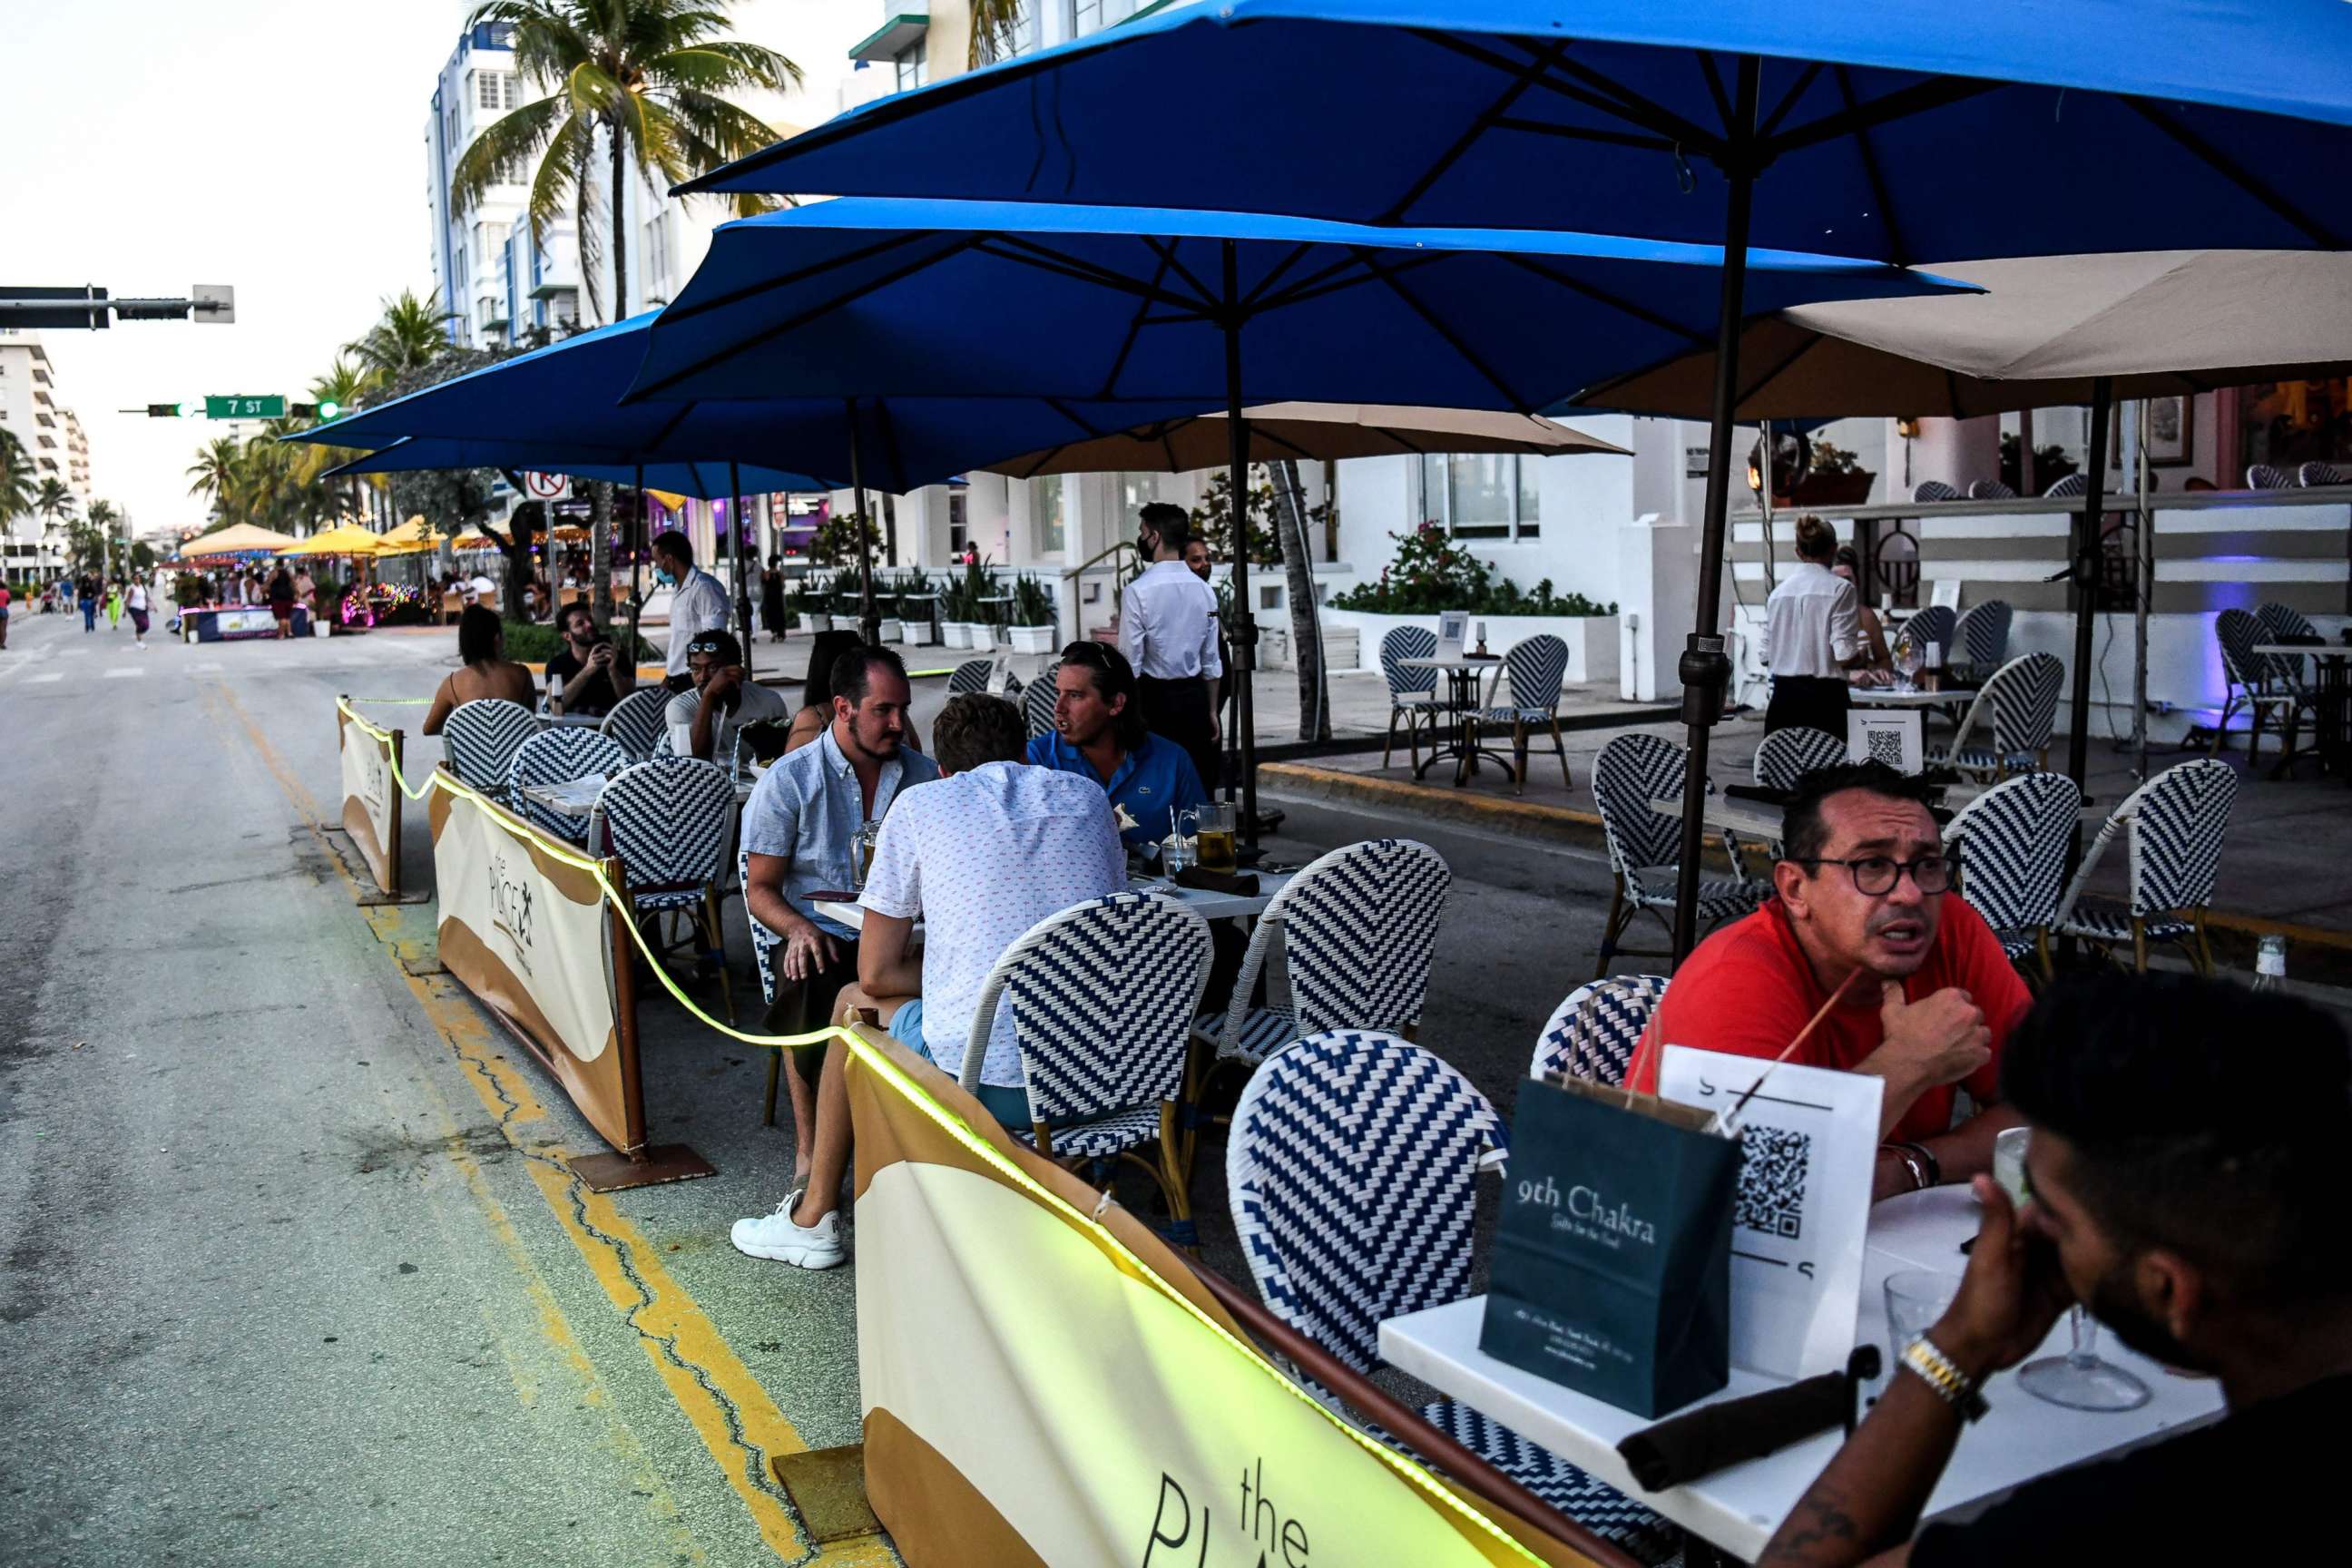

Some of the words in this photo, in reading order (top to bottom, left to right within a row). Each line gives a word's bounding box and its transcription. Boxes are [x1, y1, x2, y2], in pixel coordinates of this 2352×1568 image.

[227, 399, 239, 415] 7
[245, 399, 262, 414] ST
[1516, 1176, 1561, 1207] 9th
[1568, 1185, 1656, 1244] Chakra
[1240, 1456, 1308, 1568] the
